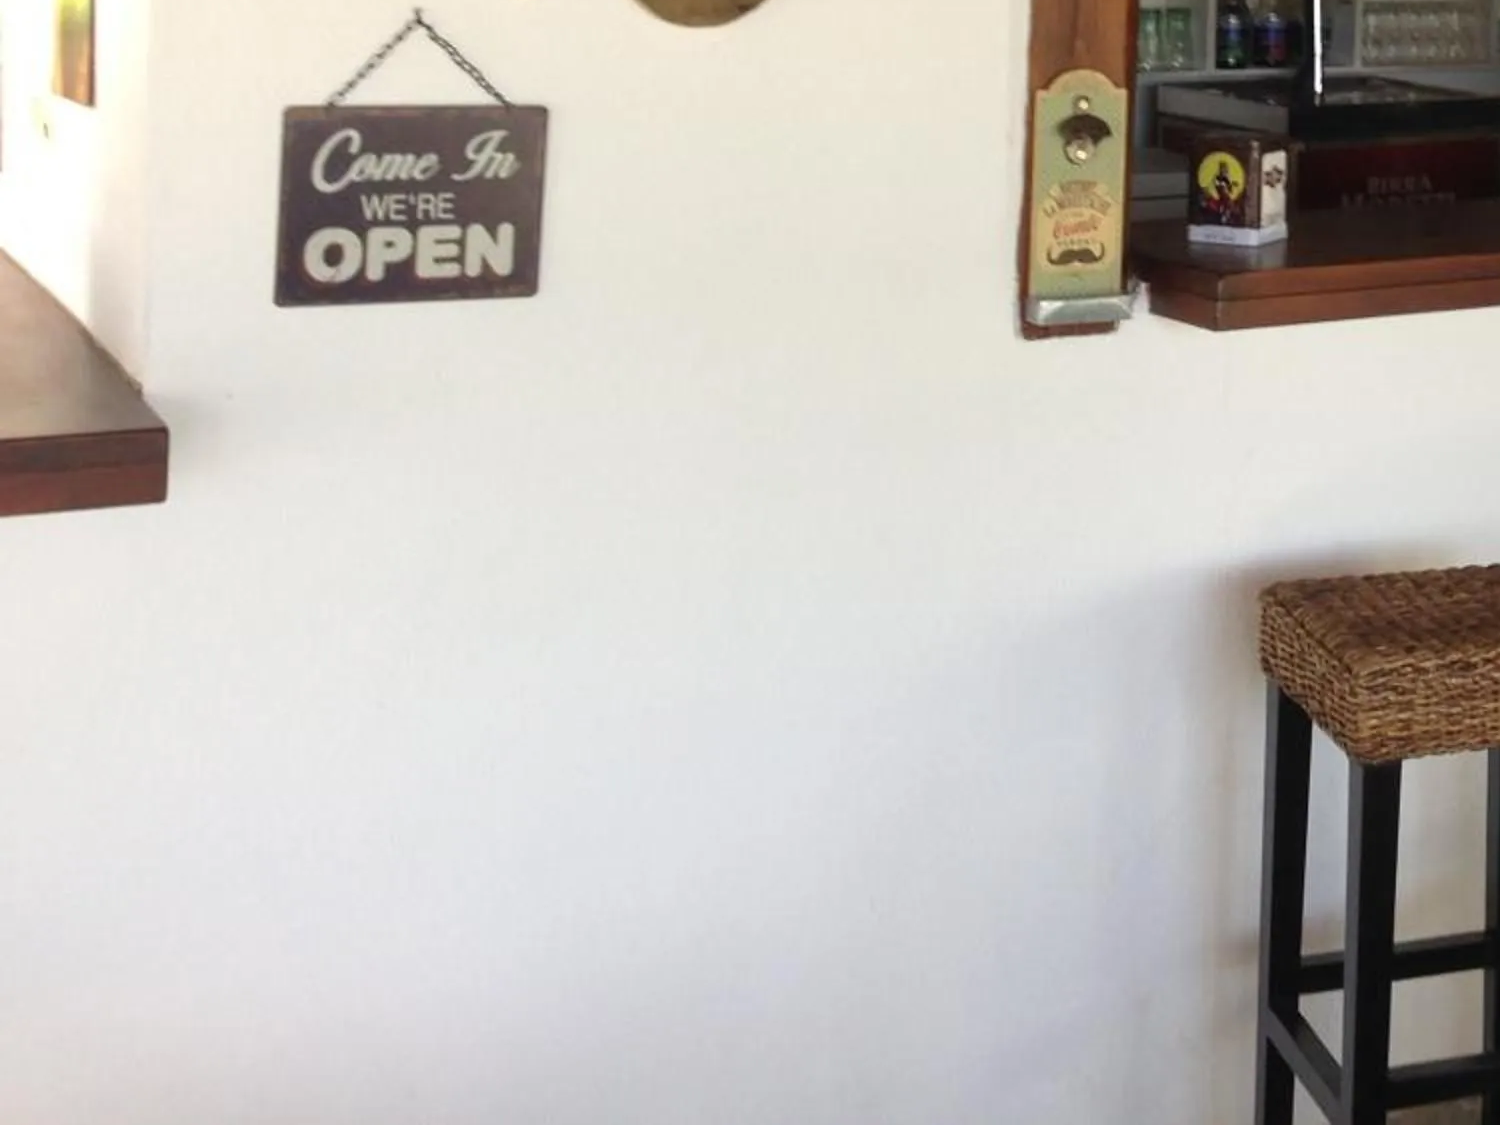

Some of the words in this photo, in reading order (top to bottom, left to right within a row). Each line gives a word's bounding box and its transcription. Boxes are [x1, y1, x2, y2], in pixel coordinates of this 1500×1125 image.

[311, 128, 441, 193] Come
[452, 130, 520, 181] In
[361, 192, 456, 221] WE'RE
[303, 222, 515, 283] OPEN
